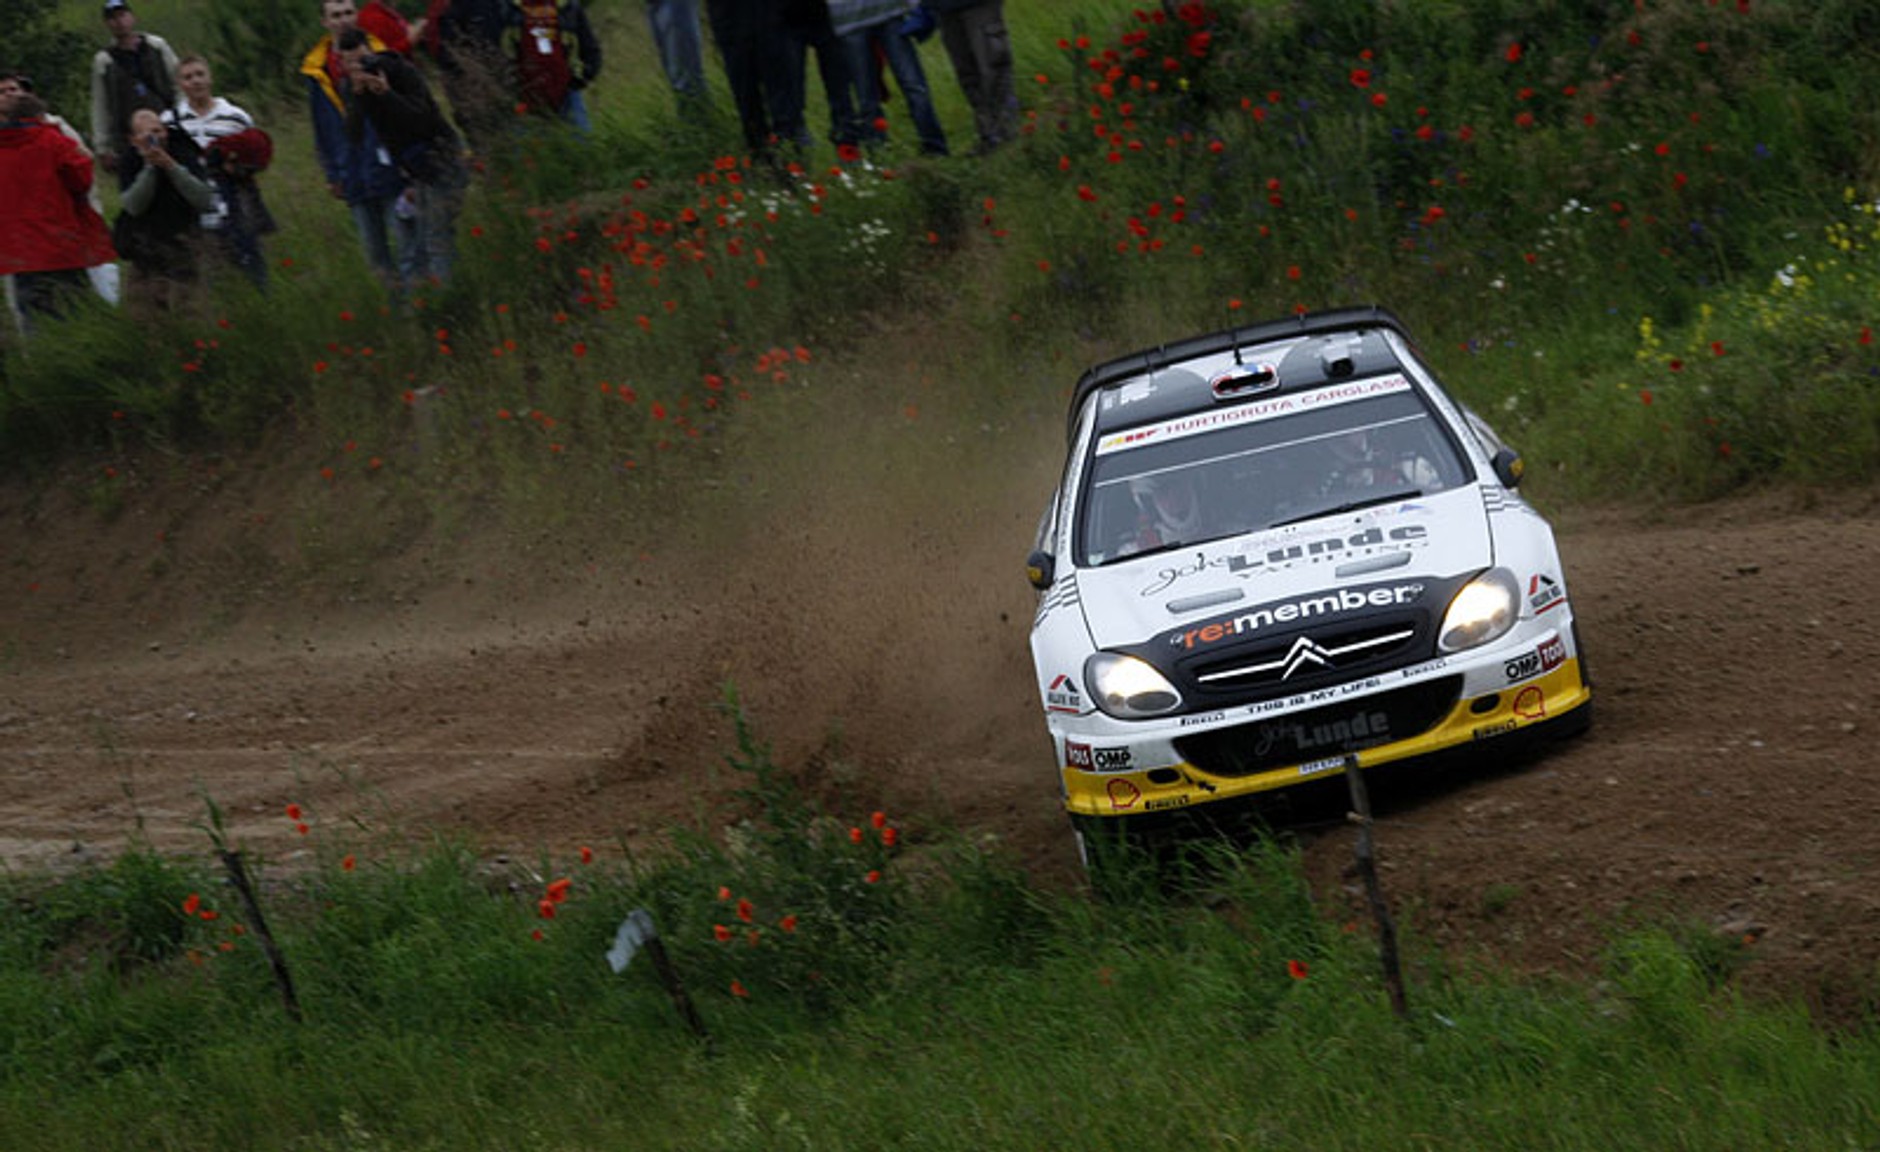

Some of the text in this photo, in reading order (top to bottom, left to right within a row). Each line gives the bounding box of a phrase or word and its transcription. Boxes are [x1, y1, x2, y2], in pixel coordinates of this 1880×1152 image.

[1165, 401, 1293, 434] HURTIGRUTA
[1227, 526, 1427, 573] Lunde
[1311, 689, 1336, 702] MY
[1295, 711, 1391, 749] Lunde
[1095, 751, 1132, 768] OMP
